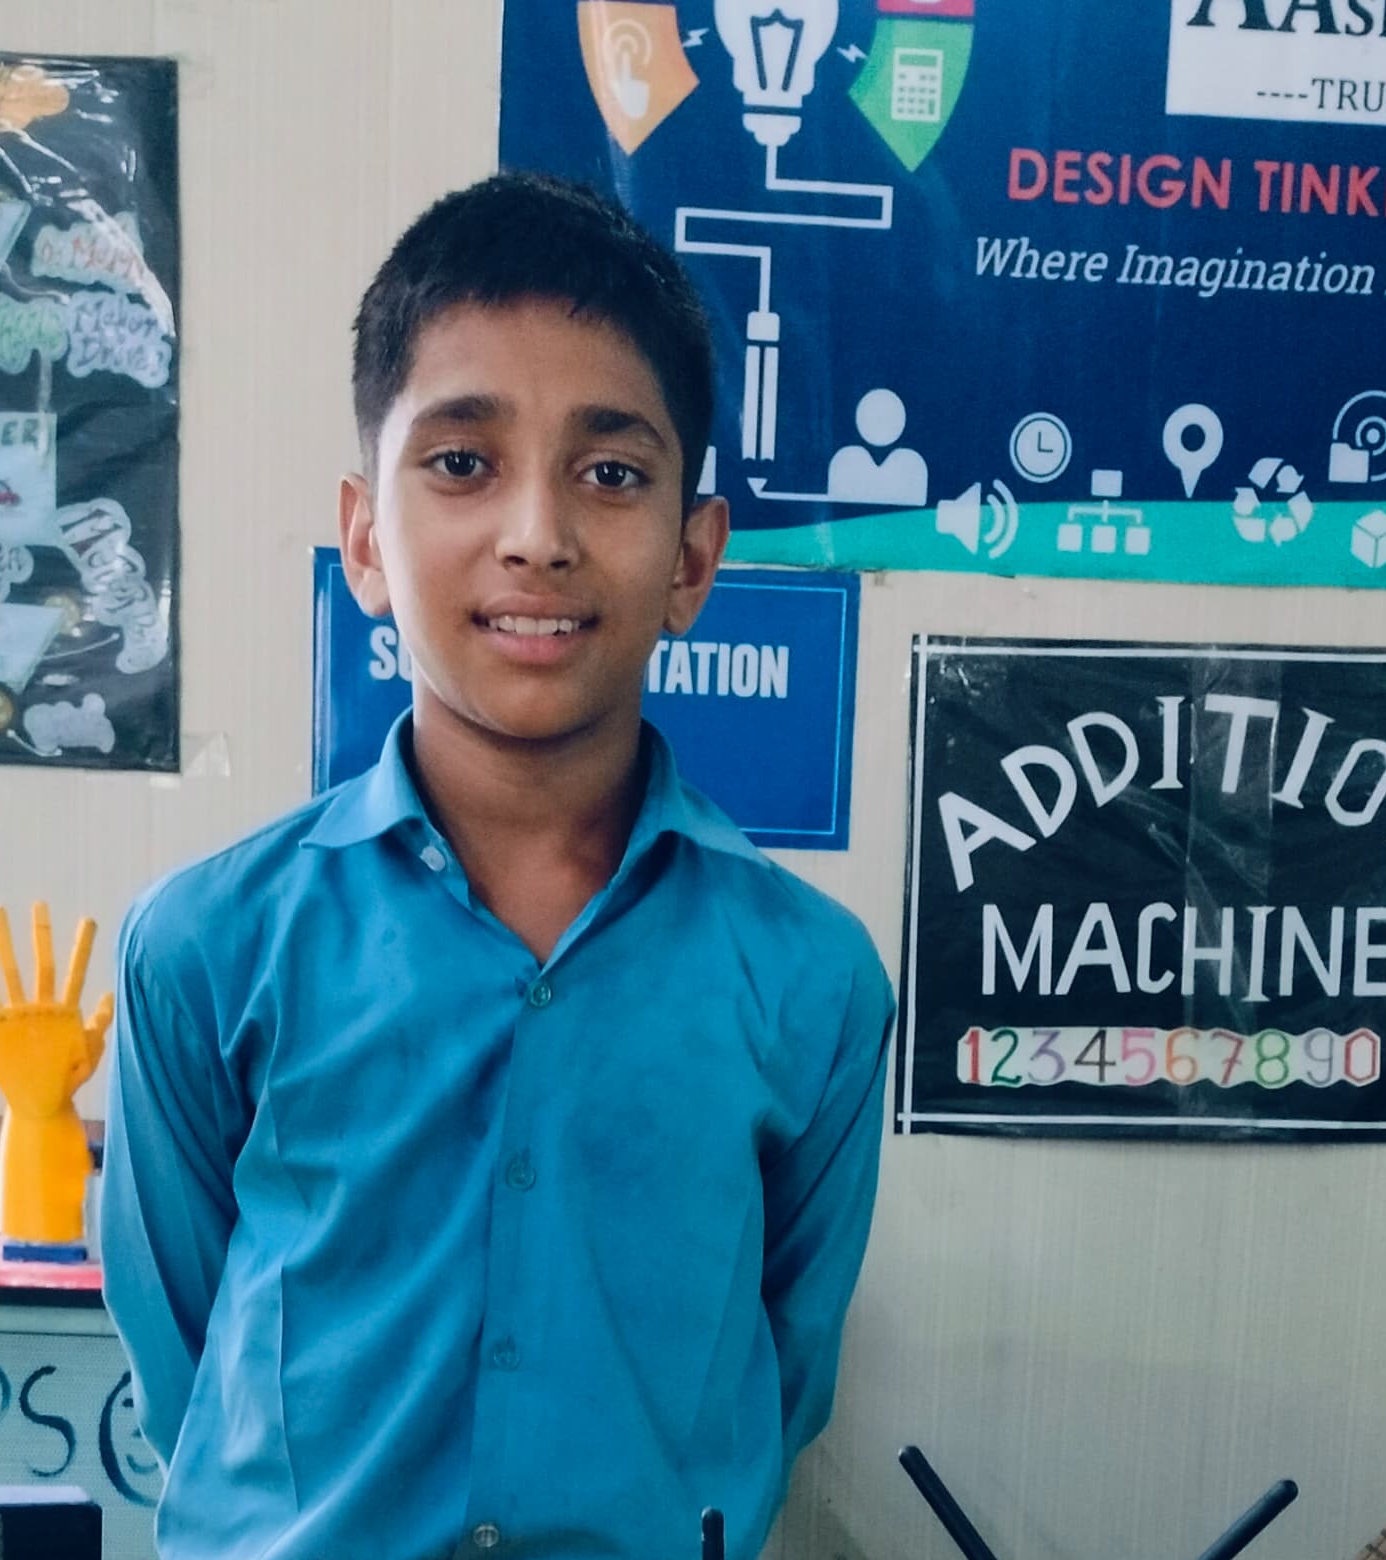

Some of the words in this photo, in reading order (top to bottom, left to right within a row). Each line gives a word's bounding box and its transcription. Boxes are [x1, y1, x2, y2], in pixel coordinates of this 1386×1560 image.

[1007, 148, 1233, 210] DESIGN
[975, 236, 1109, 283] Where
[1116, 244, 1376, 298] Imagination
[647, 640, 790, 699] TATION
